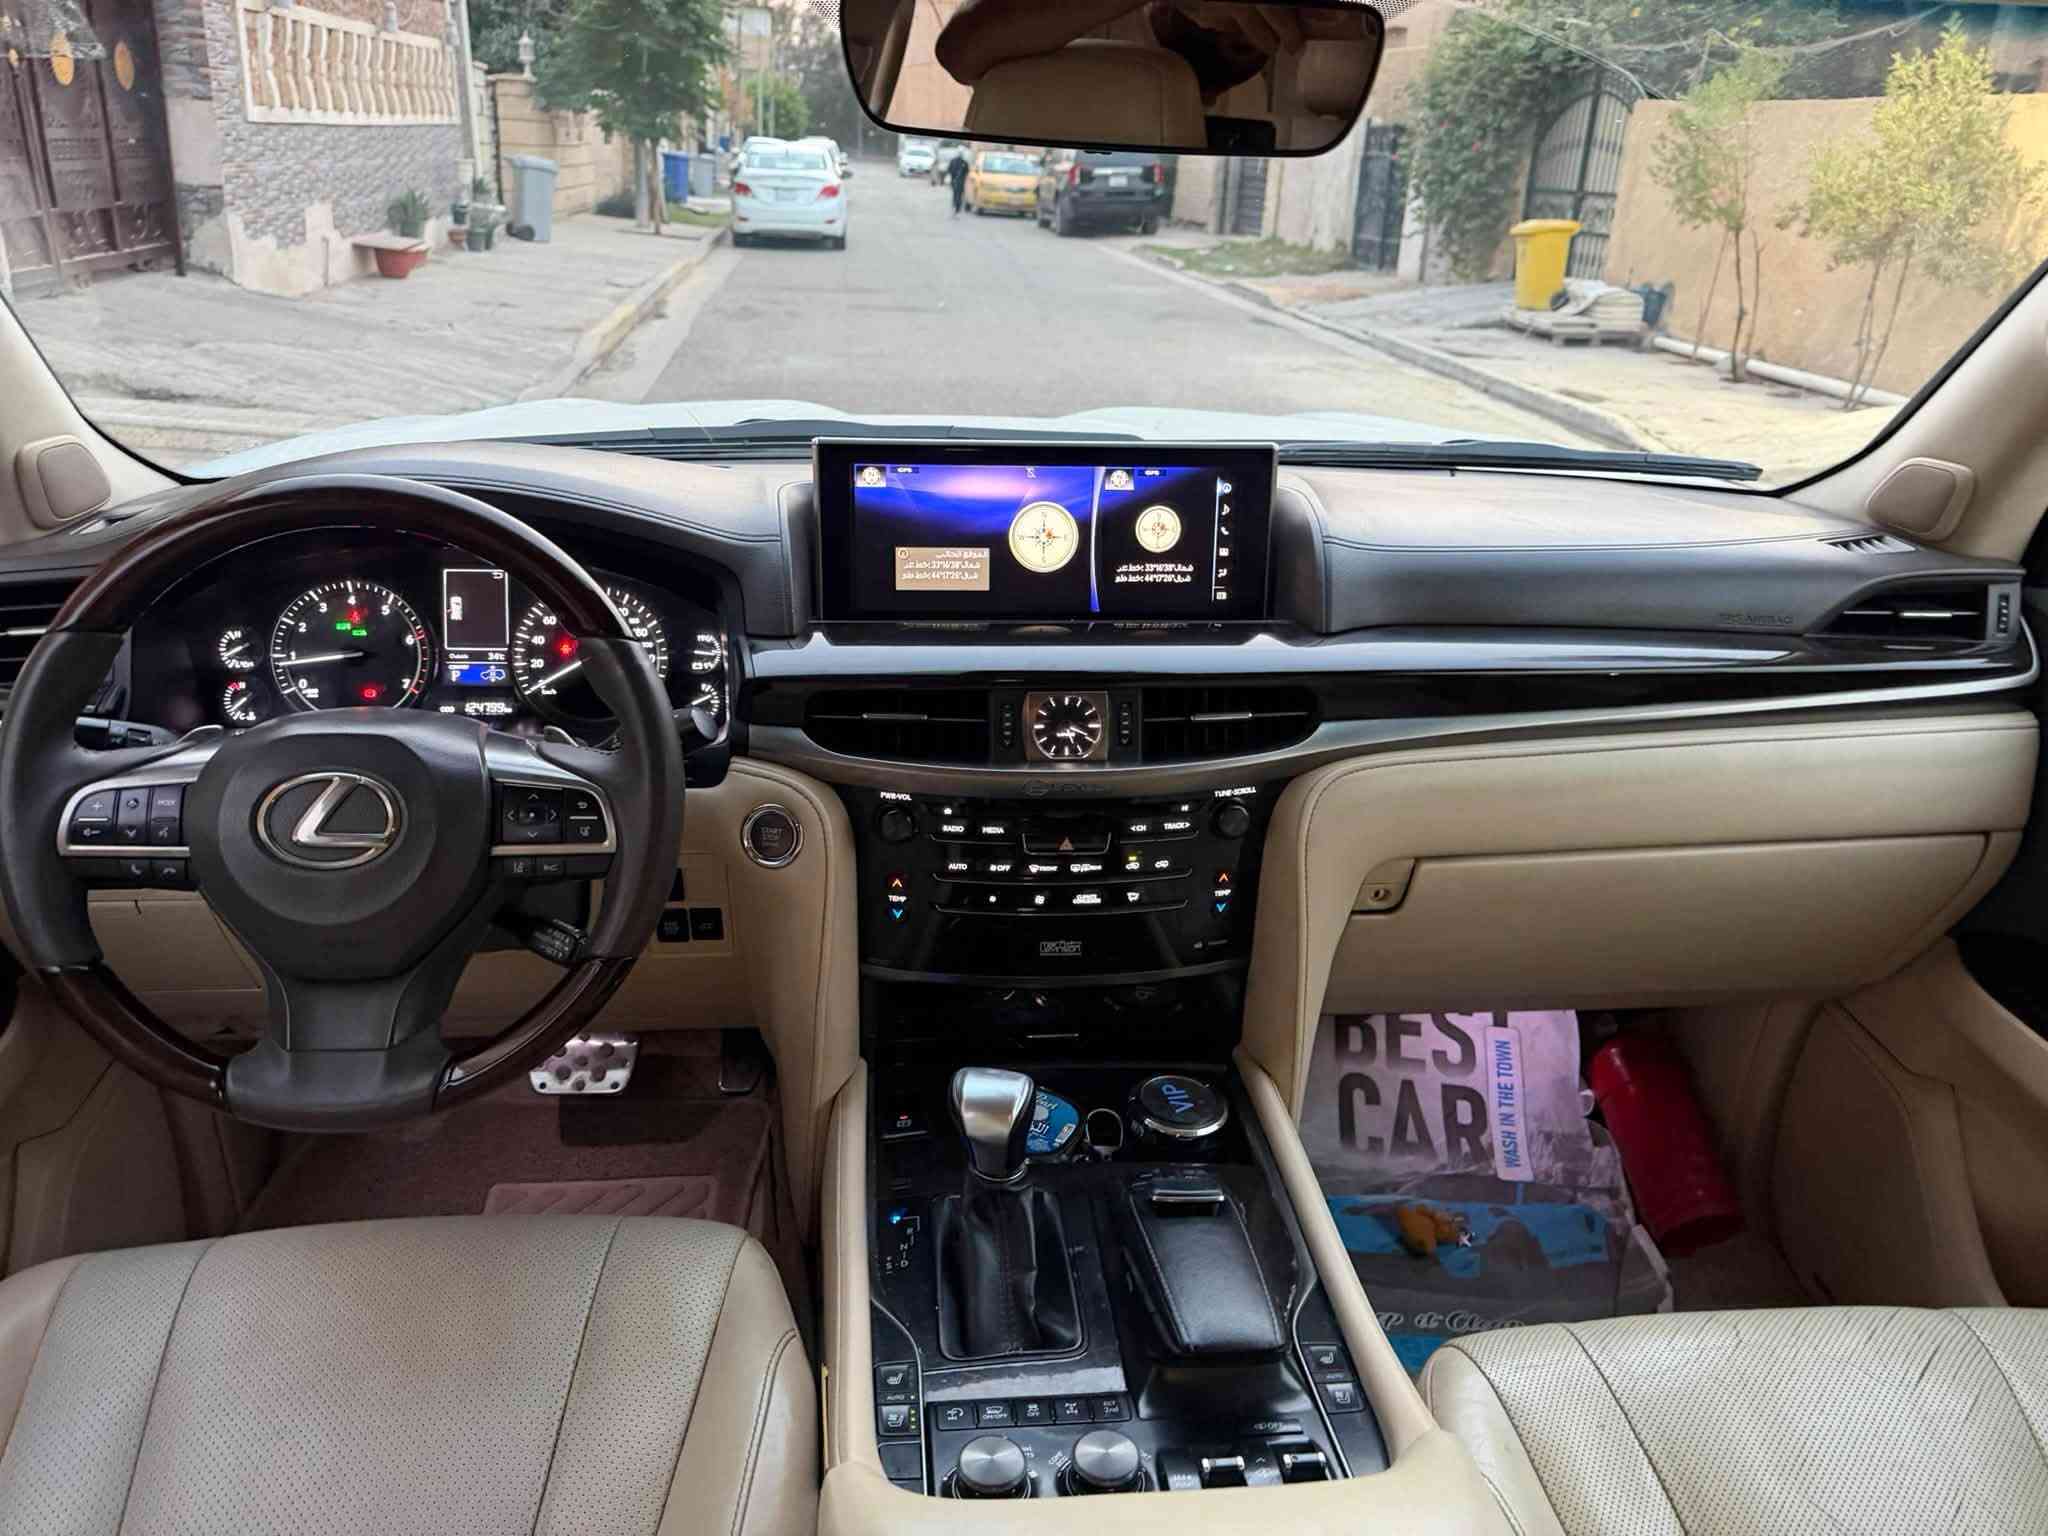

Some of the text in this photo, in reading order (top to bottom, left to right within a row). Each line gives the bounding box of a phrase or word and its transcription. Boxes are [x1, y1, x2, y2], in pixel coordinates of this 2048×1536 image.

[347, 596, 356, 605] 4
[319, 603, 328, 613] 3
[381, 606, 390, 615] 5
[542, 616, 557, 626] 60
[299, 623, 307, 633] 2
[405, 636, 415, 645] 6
[531, 635, 545, 645] 40
[290, 651, 297, 660] 1
[530, 658, 544, 669] 20
[452, 670, 461, 682] P
[298, 679, 308, 689] 0
[401, 679, 411, 689] 7
[942, 825, 965, 833] RADIO
[982, 826, 1005, 834] MEDIA
[1214, 889, 1231, 897] TEMP
[1335, 1010, 1508, 1076] BES
[1161, 1084, 1195, 1113] VIP
[1494, 1040, 1521, 1168] WASH IN THE TOWN
[1338, 1072, 1490, 1163] CAR
